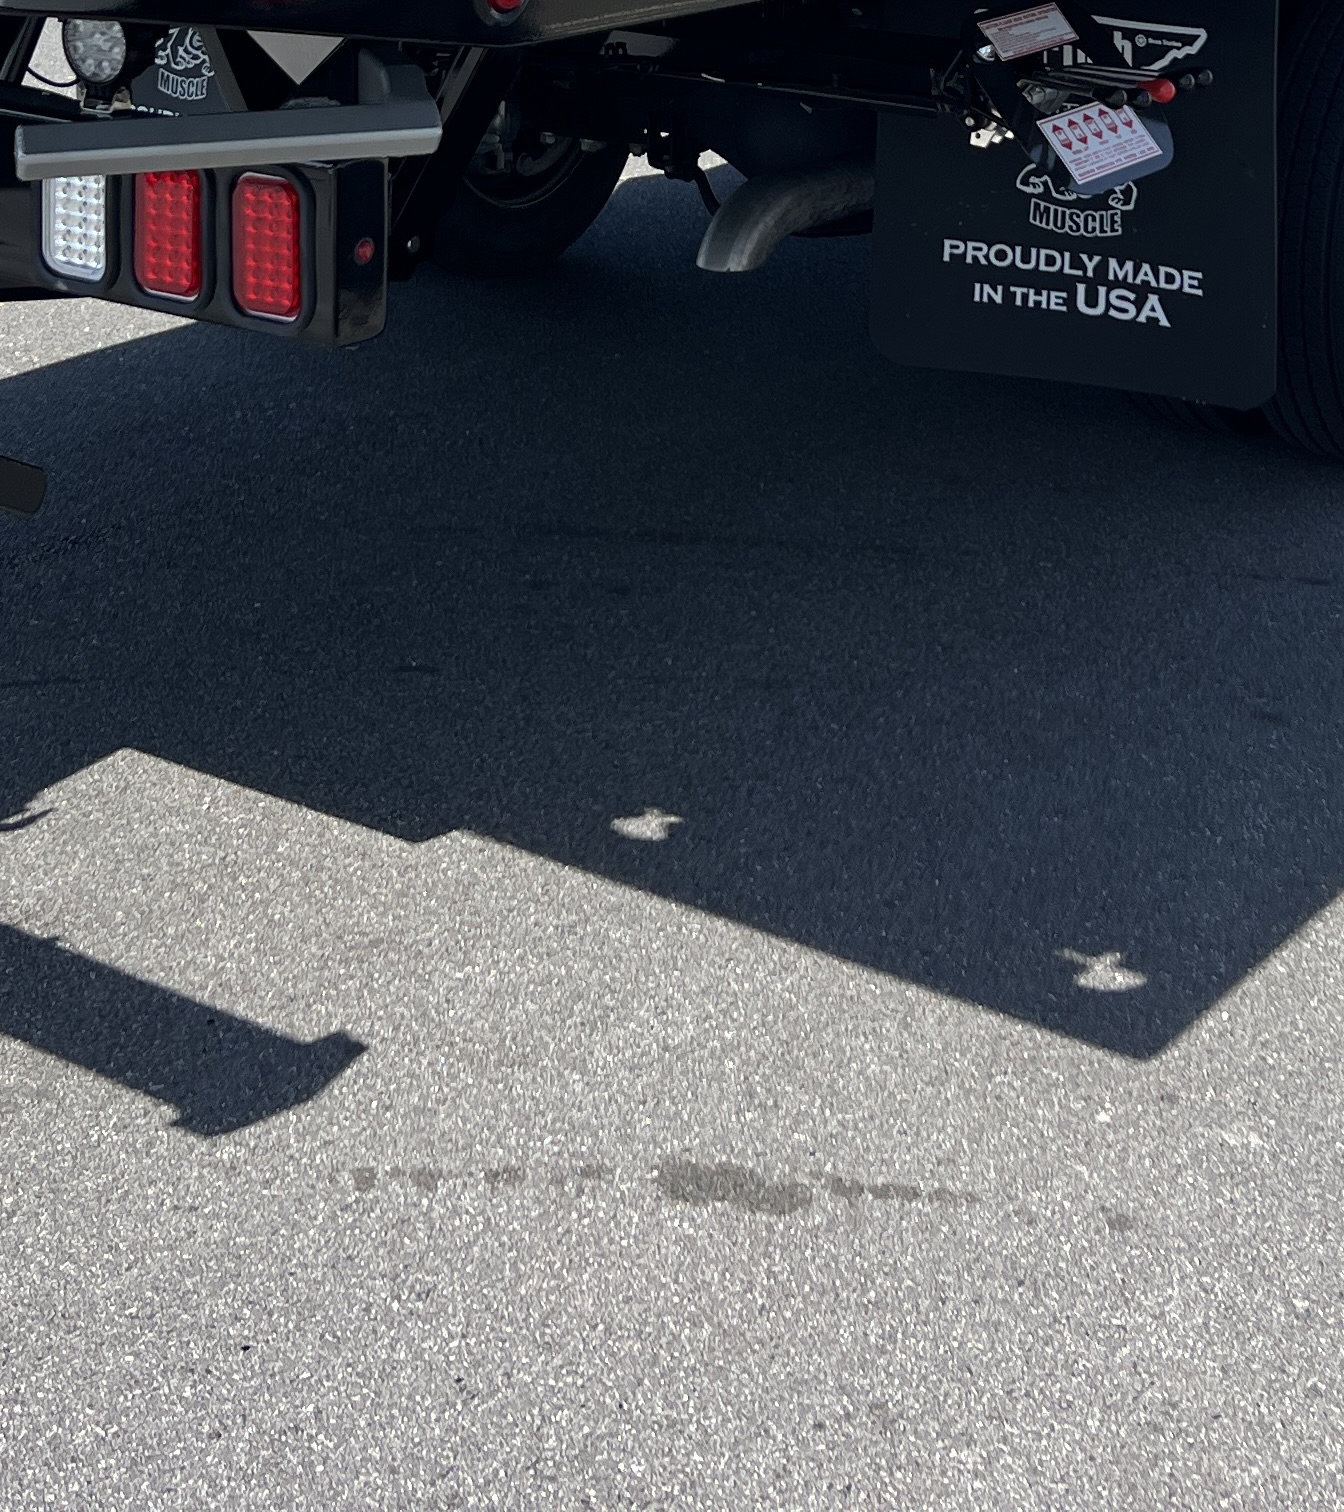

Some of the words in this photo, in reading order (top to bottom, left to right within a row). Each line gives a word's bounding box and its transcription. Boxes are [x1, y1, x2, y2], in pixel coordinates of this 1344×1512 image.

[158, 68, 208, 100] MUSCLE
[1029, 197, 1122, 237] MUSCLE
[942, 238, 1102, 278] PROUDLY
[1107, 257, 1204, 297] MADE
[973, 282, 1003, 305] IN
[1010, 285, 1068, 312] THE
[1075, 282, 1171, 328] USA
